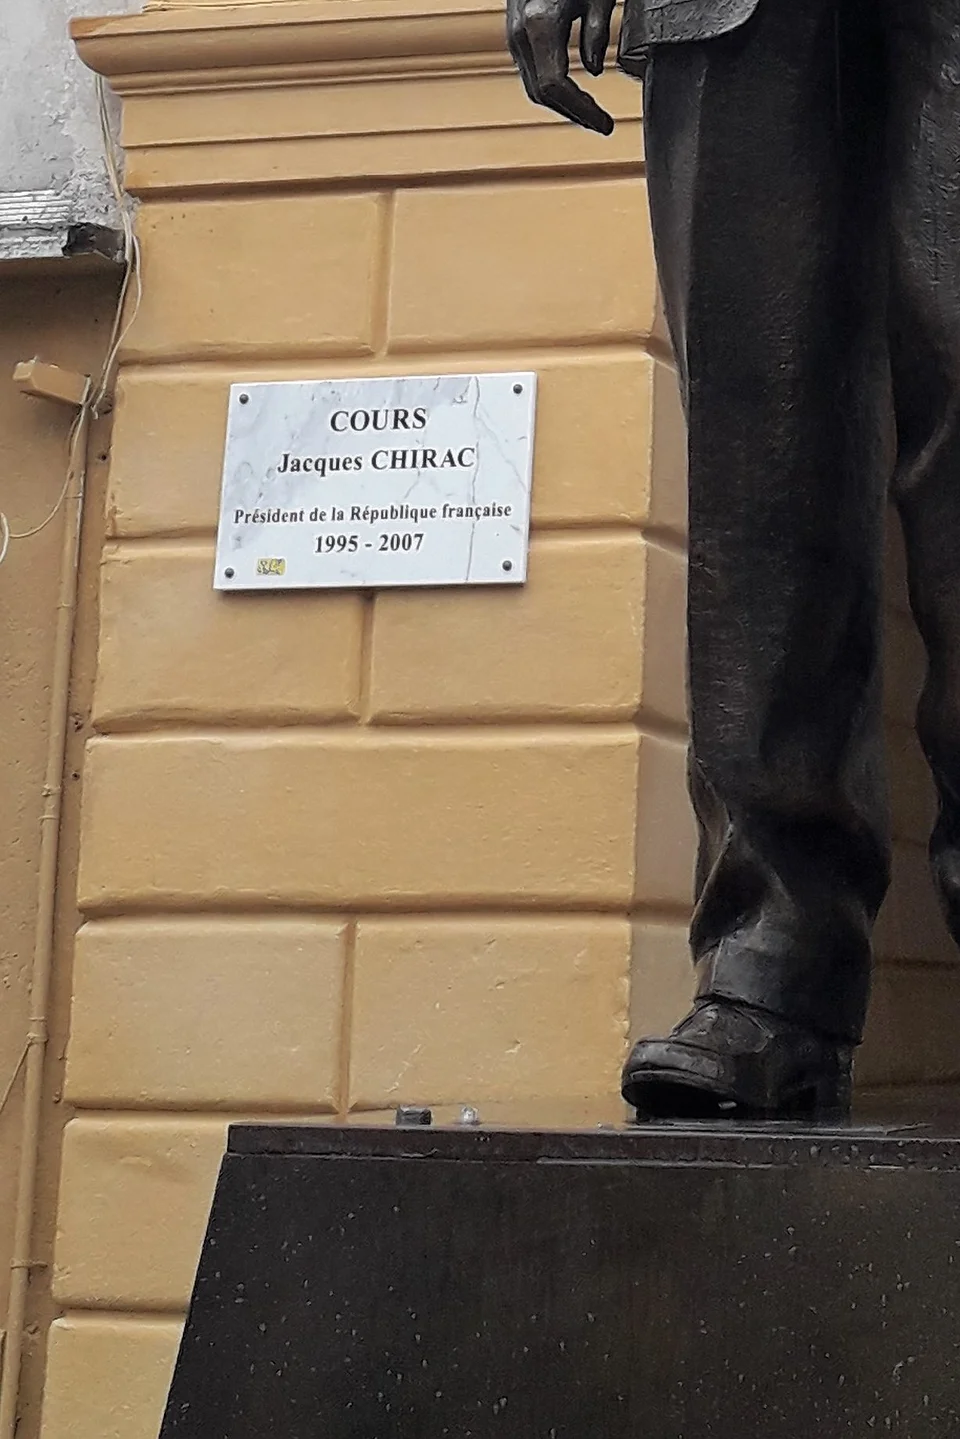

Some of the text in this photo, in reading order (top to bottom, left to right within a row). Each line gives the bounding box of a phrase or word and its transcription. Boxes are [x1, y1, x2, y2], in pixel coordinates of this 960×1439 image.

[330, 408, 426, 431] COURS
[277, 447, 475, 477] Jacques CHIRAC
[234, 502, 512, 524] Président de la République française
[315, 534, 358, 553] 1995
[378, 533, 424, 552] 2007
